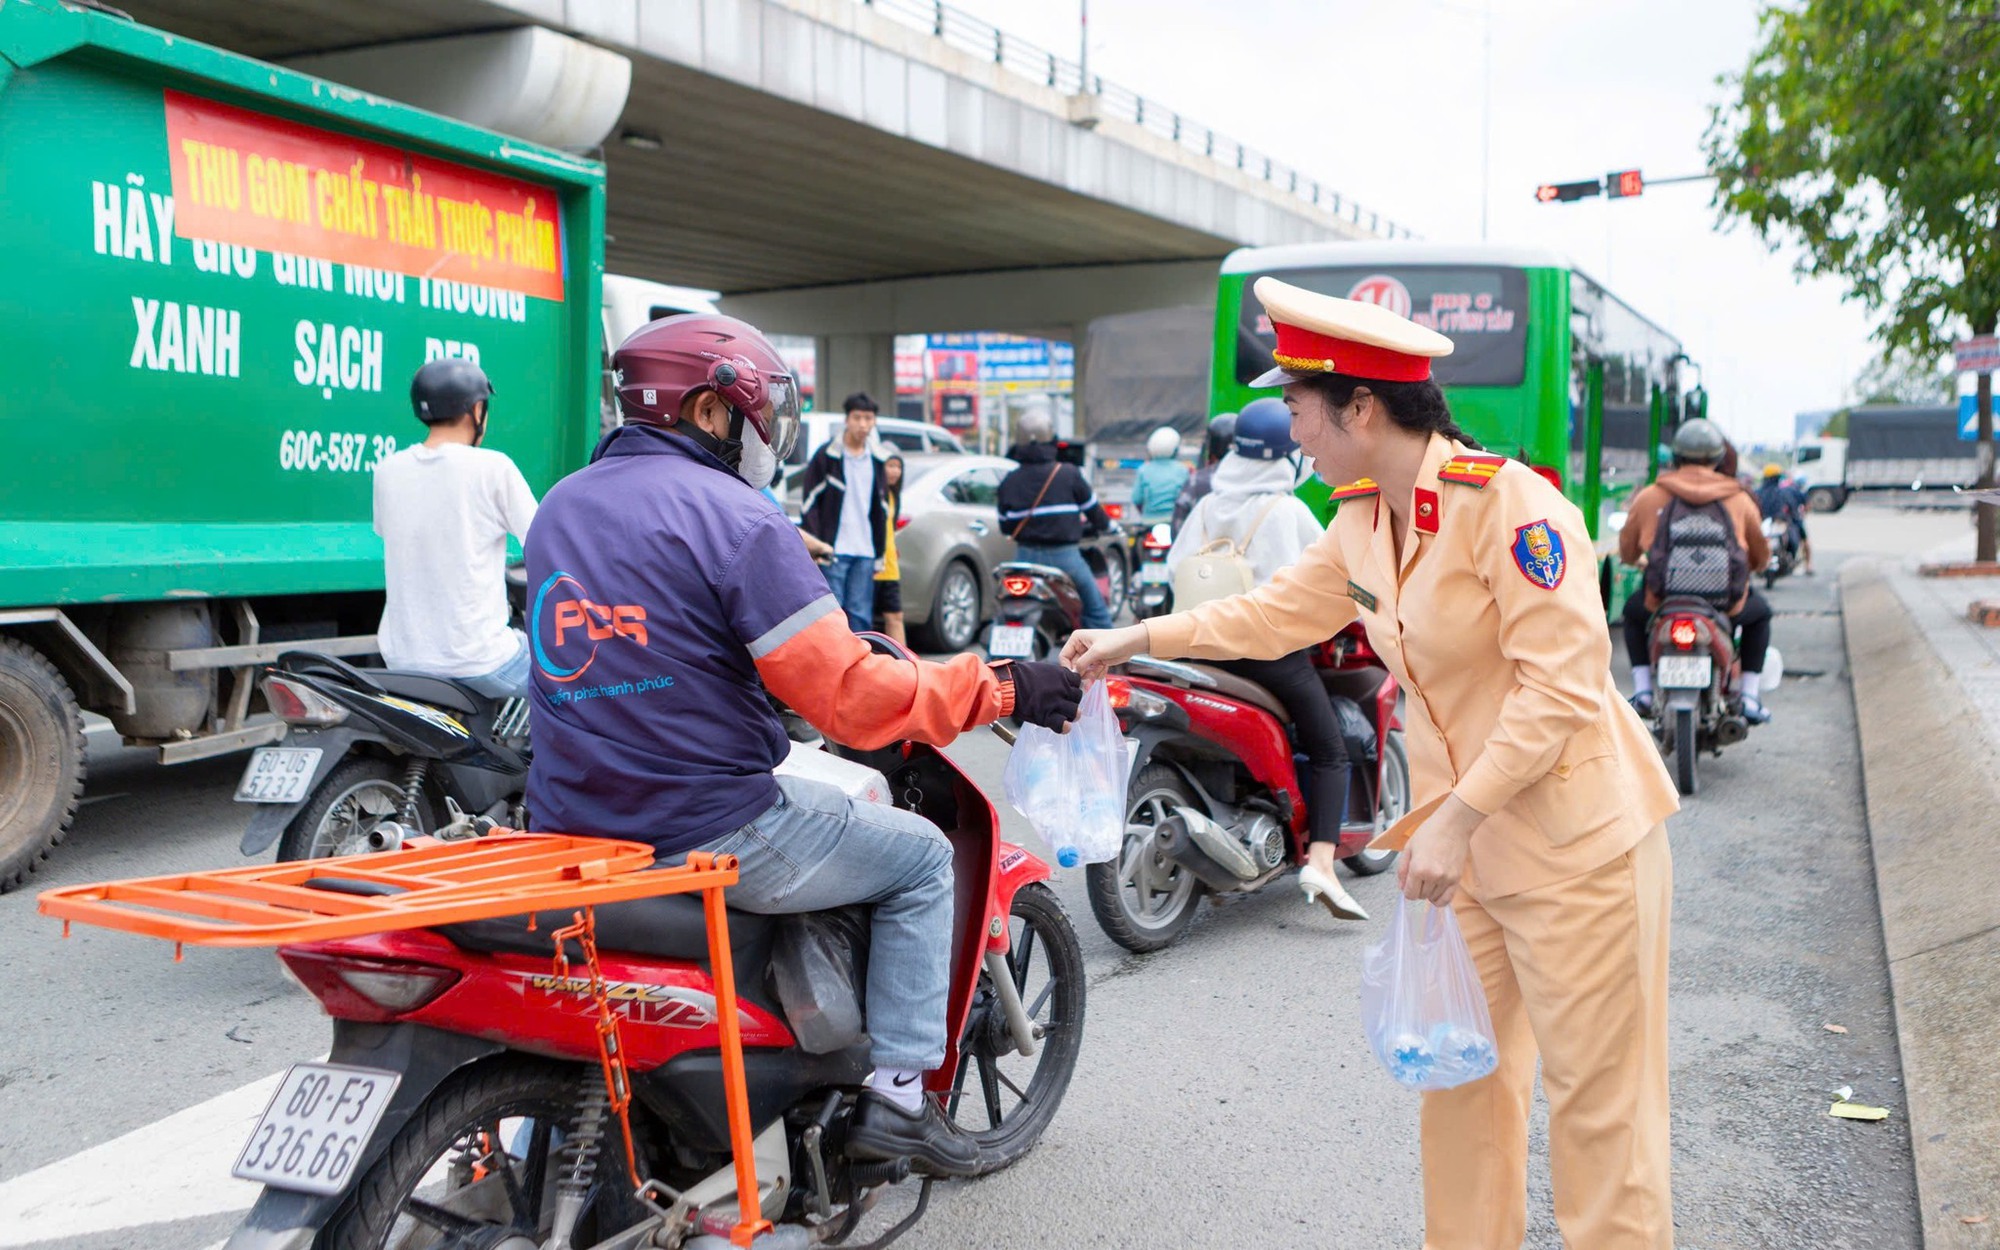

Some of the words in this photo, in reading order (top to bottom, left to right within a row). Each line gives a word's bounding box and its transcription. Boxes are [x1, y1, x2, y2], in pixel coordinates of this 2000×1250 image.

[92, 172, 175, 265] HÃY
[182, 138, 240, 212] THU
[246, 153, 310, 224] GOM
[315, 158, 378, 240] CHẤT
[382, 173, 436, 249] THẢI
[437, 198, 493, 271] THỰC
[496, 197, 556, 273] PHẨM
[130, 297, 240, 378] XANH
[294, 320, 383, 399] SẠCH
[600, 680, 634, 699] hạnh
[637, 675, 675, 694] phúc
[285, 1072, 375, 1124] 60-F3
[246, 1122, 358, 1181] 336.66
